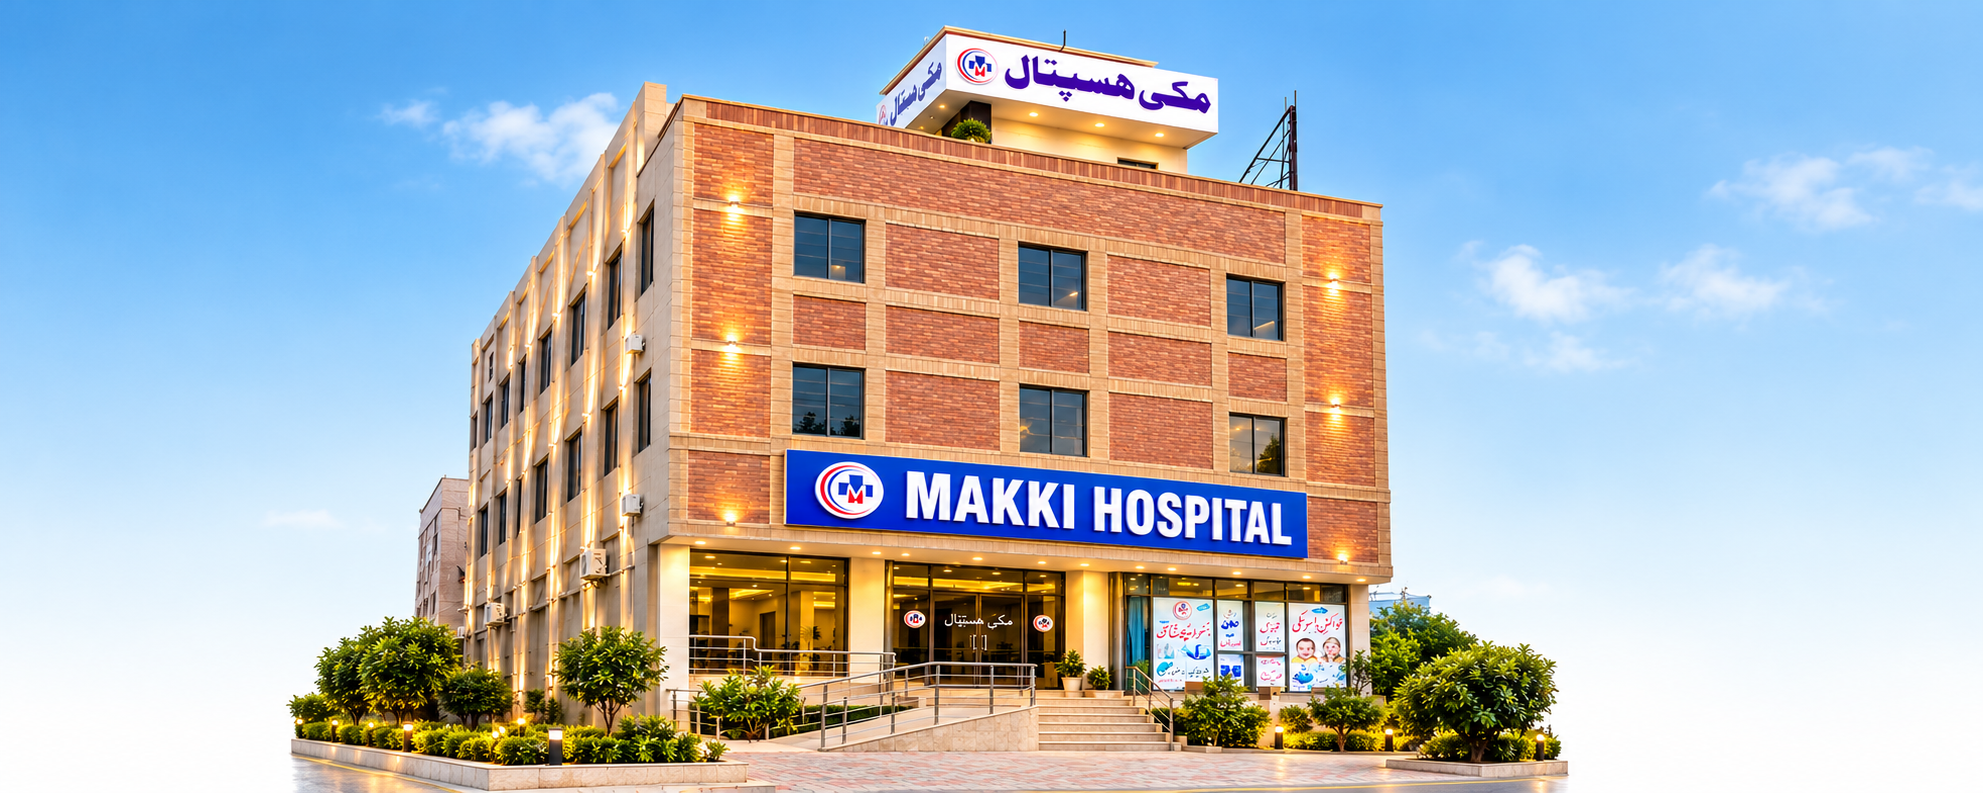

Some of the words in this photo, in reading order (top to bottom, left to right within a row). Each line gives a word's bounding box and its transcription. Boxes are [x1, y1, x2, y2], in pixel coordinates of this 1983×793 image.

[1004, 54, 1136, 102] هسپتال
[1138, 81, 1212, 114] مکی
[906, 470, 1076, 530] MAKKI
[1093, 486, 1293, 546] HOSPITAL
